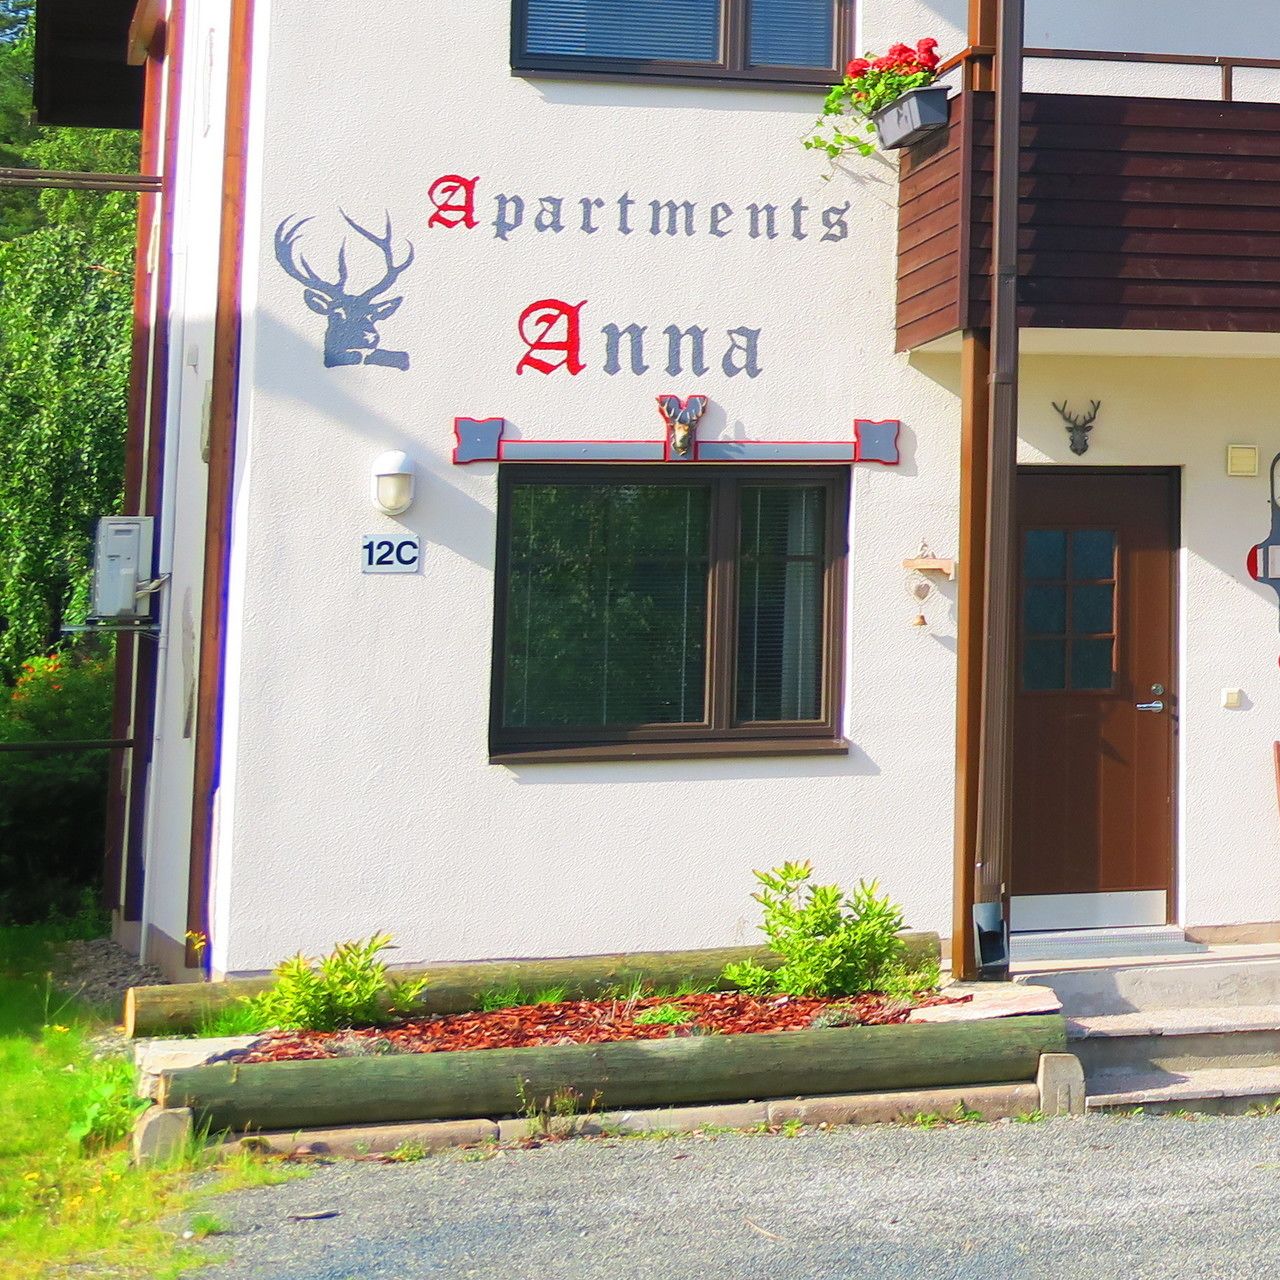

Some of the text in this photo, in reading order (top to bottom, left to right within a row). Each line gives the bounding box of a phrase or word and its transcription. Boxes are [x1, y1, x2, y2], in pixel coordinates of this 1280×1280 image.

[428, 175, 851, 243] Apartments
[516, 299, 763, 379] Anna
[363, 541, 418, 566] 12C
